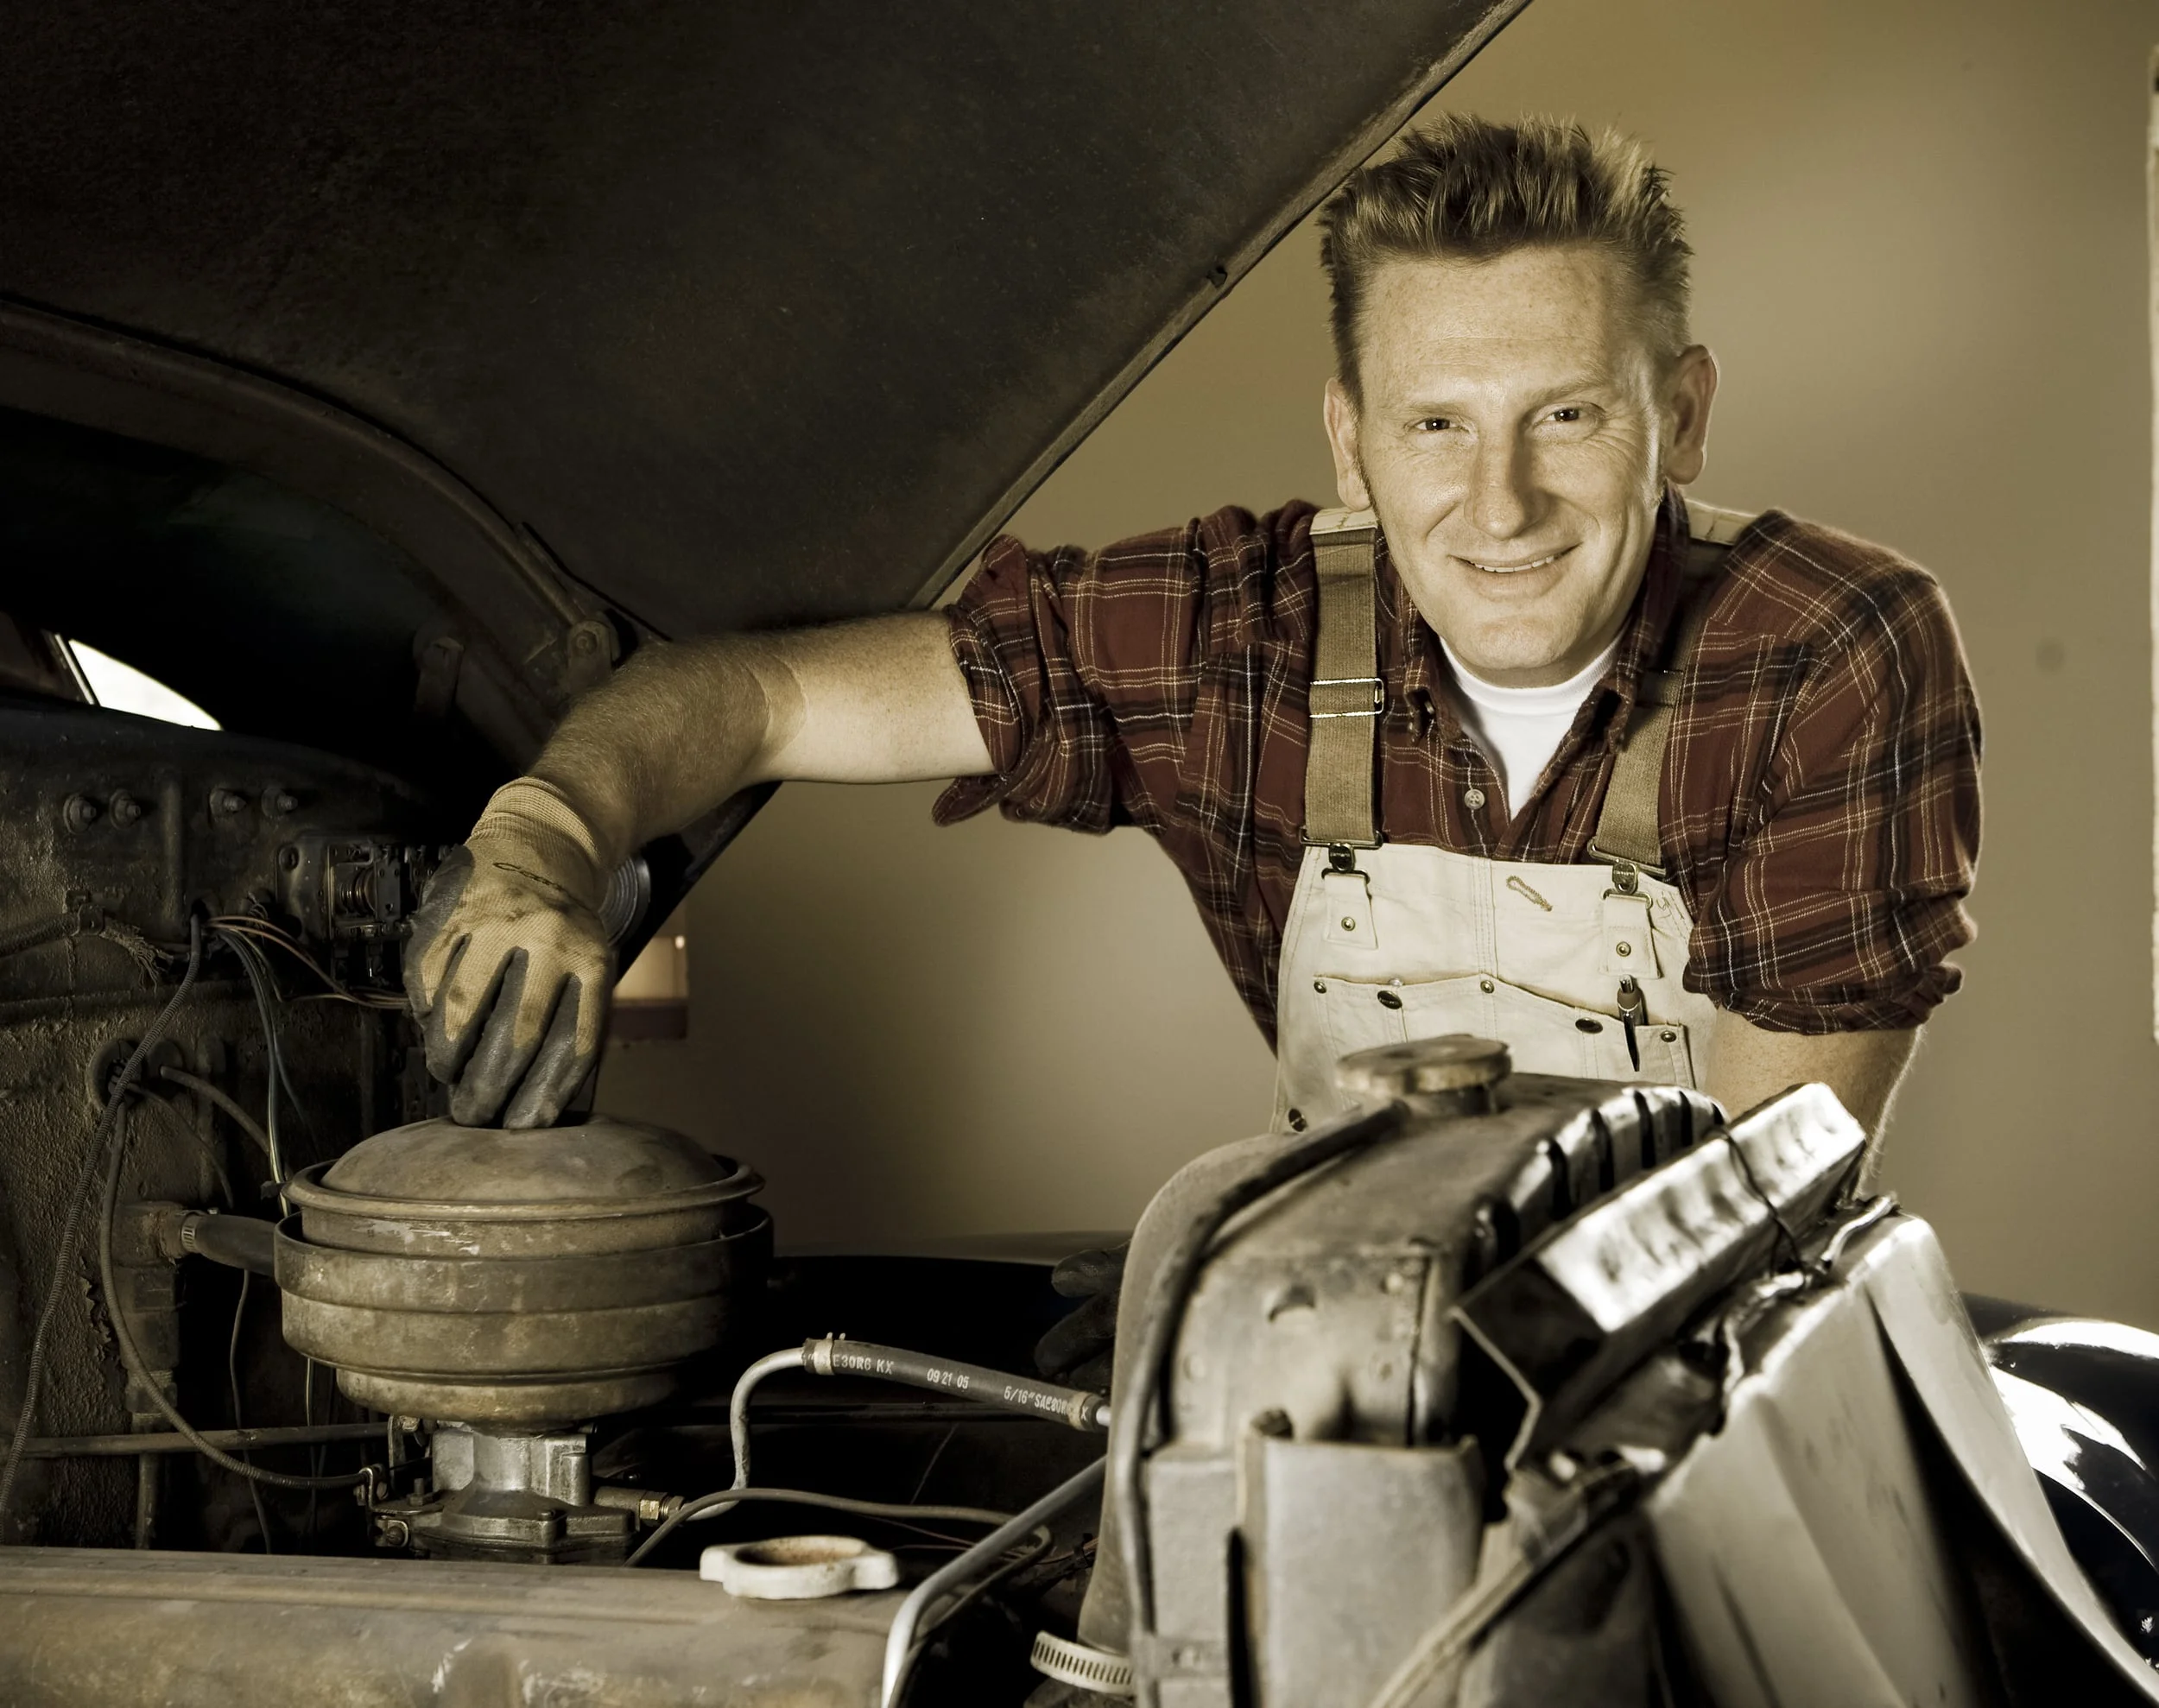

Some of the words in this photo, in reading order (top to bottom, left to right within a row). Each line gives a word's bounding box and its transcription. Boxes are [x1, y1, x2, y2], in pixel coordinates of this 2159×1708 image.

[876, 1358, 895, 1375] KX
[927, 1368, 940, 1383] 09
[941, 1371, 953, 1387] 21
[956, 1375, 970, 1389] 05
